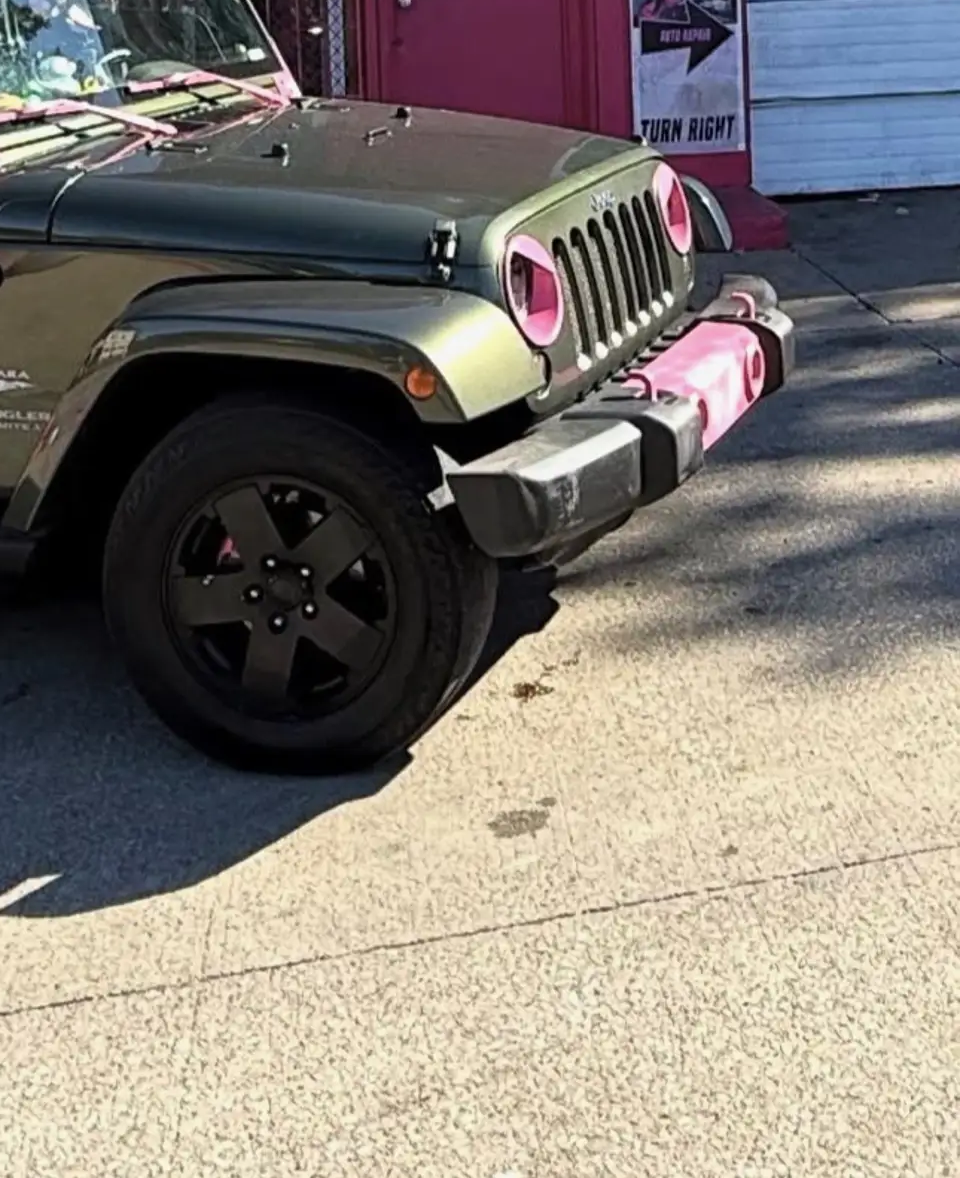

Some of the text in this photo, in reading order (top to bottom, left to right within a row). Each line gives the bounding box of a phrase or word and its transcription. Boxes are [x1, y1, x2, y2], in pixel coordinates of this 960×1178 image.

[660, 28, 711, 42] AUTO REPAIR
[641, 115, 736, 142] TURN RIGHT
